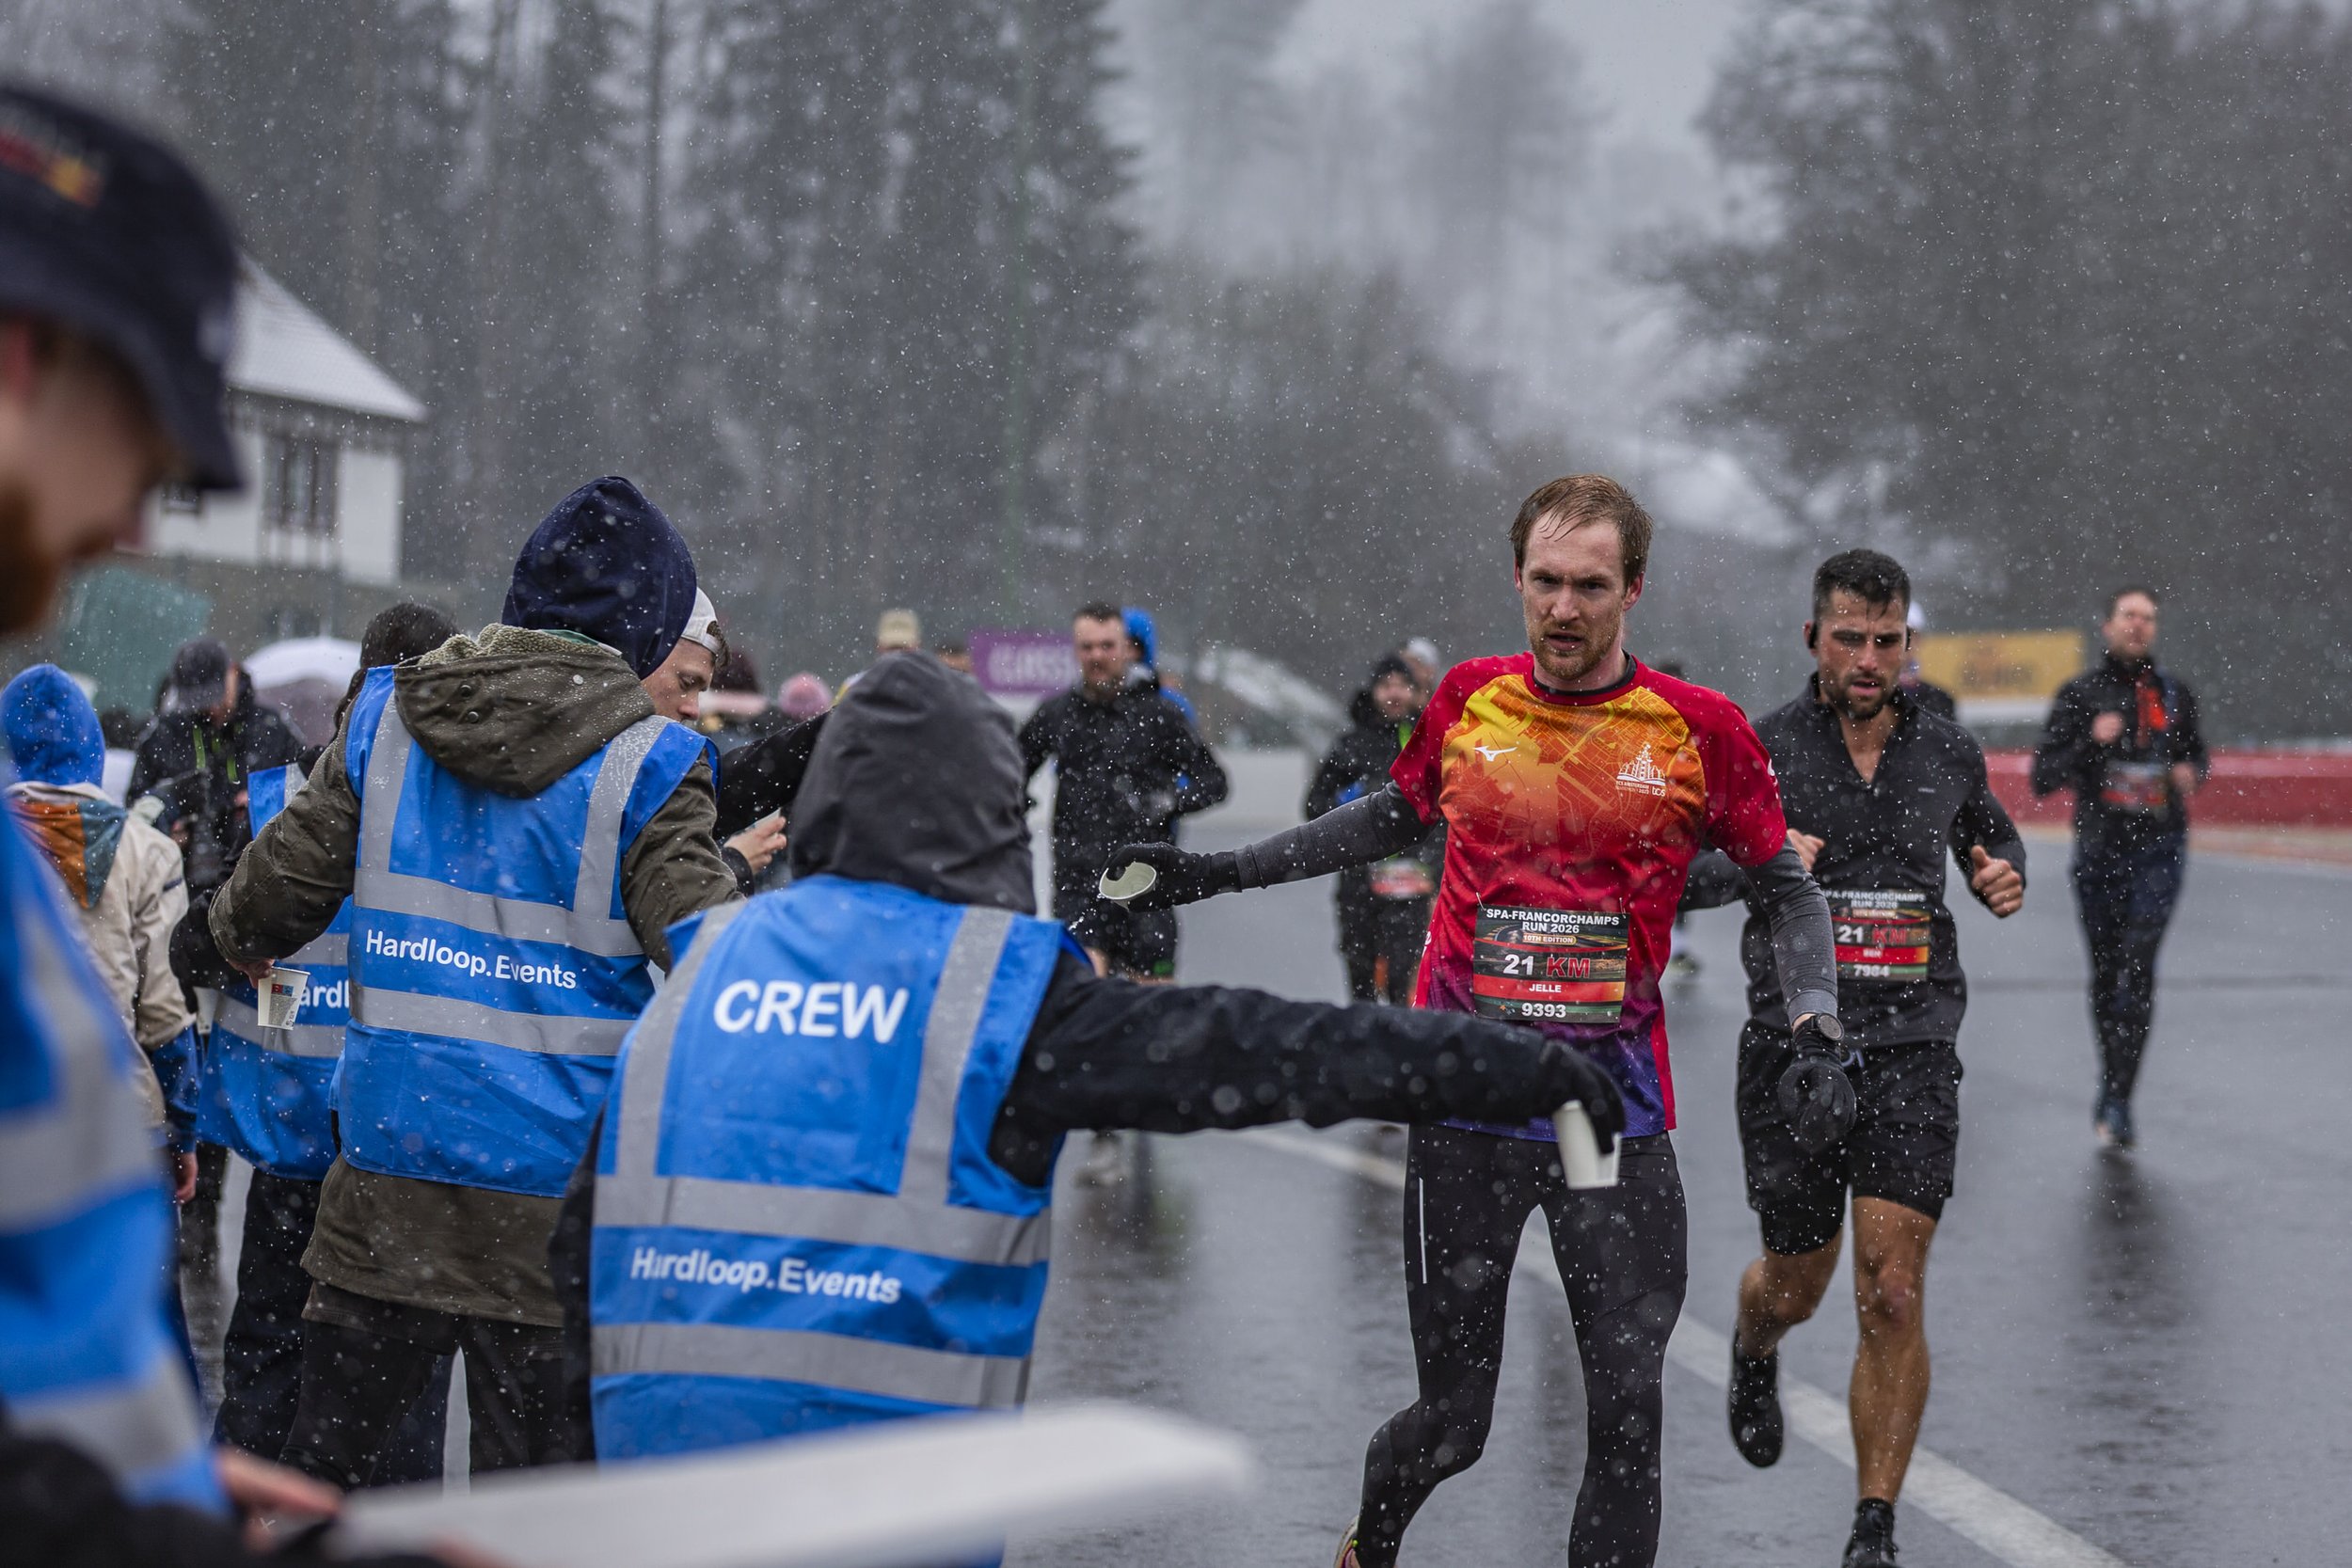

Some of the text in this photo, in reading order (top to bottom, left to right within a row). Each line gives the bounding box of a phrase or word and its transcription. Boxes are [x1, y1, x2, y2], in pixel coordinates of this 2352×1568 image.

[1851, 900, 1872, 909] RUN
[1486, 909, 1619, 926] SPA-FRANCORCHAMPS
[1522, 922, 1580, 934] RUN 2026
[1837, 925, 1906, 944] 21 KM
[1523, 934, 1573, 943] 10TH EDITION
[366, 929, 577, 990] Hardloop.Events
[1503, 954, 1591, 978] 21 KM
[300, 979, 350, 1008] ardl
[1529, 983, 1562, 993] JELLE
[714, 979, 910, 1043] CREW
[1521, 1003, 1566, 1018] 9393
